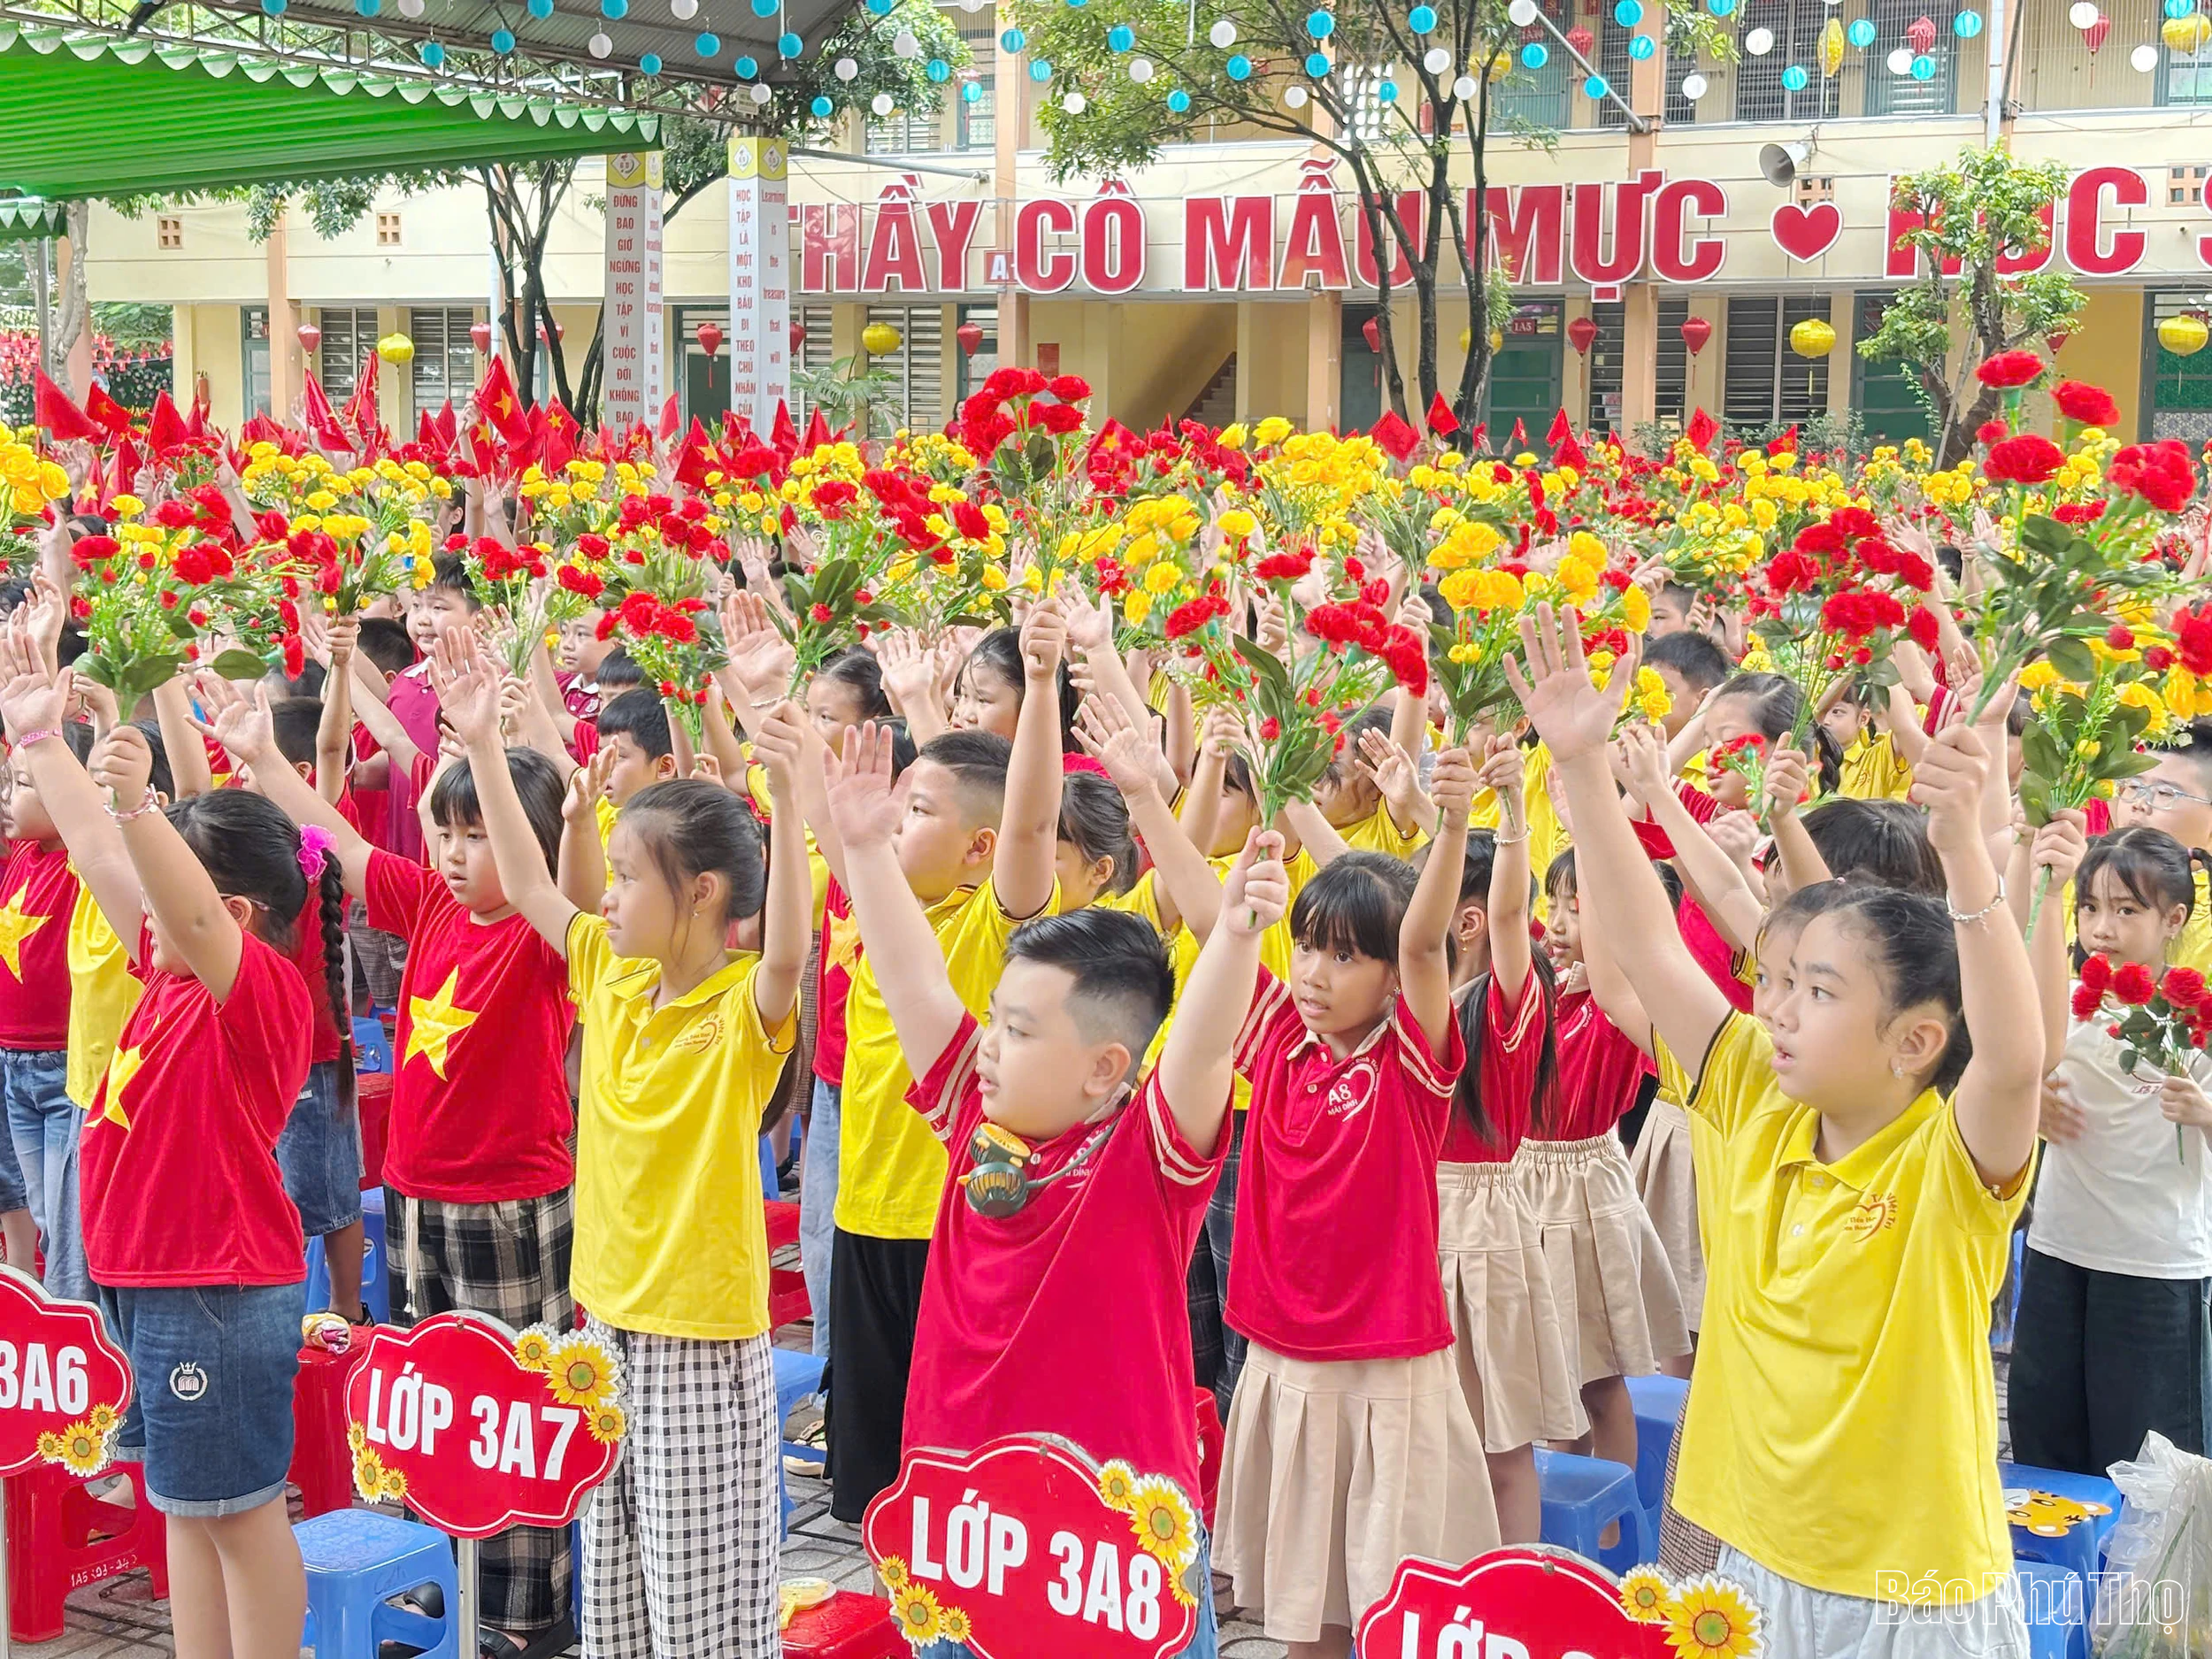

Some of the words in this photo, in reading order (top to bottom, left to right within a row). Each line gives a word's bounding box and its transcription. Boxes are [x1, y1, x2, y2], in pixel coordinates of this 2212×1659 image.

[613, 195, 638, 208] ĐỪNG
[736, 189, 751, 204] HỌC
[761, 189, 786, 204] Learning
[616, 218, 634, 229] BAO
[771, 223, 777, 235] is
[788, 173, 983, 293] HẦY
[1014, 178, 1147, 296] CÔ
[1182, 157, 1427, 291] MẪU
[1462, 168, 1729, 303] MỰC
[618, 238, 634, 251] GIỜ
[610, 258, 641, 273] NGỪNG
[736, 251, 752, 270] MỘT
[770, 255, 779, 267] the
[616, 282, 634, 296] HỌC
[736, 275, 752, 288] KHO
[616, 302, 634, 319] TẬP
[1513, 321, 1532, 333] 1A5
[612, 344, 636, 362] CUỘC
[736, 339, 755, 352] THEO
[617, 365, 632, 380] ĐỜI
[609, 388, 640, 402] KHÔNG
[616, 411, 634, 424] BAO
[1328, 1083, 1352, 1106] A8
[0, 1340, 89, 1416] 3A6
[367, 1362, 454, 1455] LỚP
[469, 1395, 580, 1480] 3A7
[910, 1488, 1028, 1596] LỚP
[1047, 1531, 1162, 1640] 3A8
